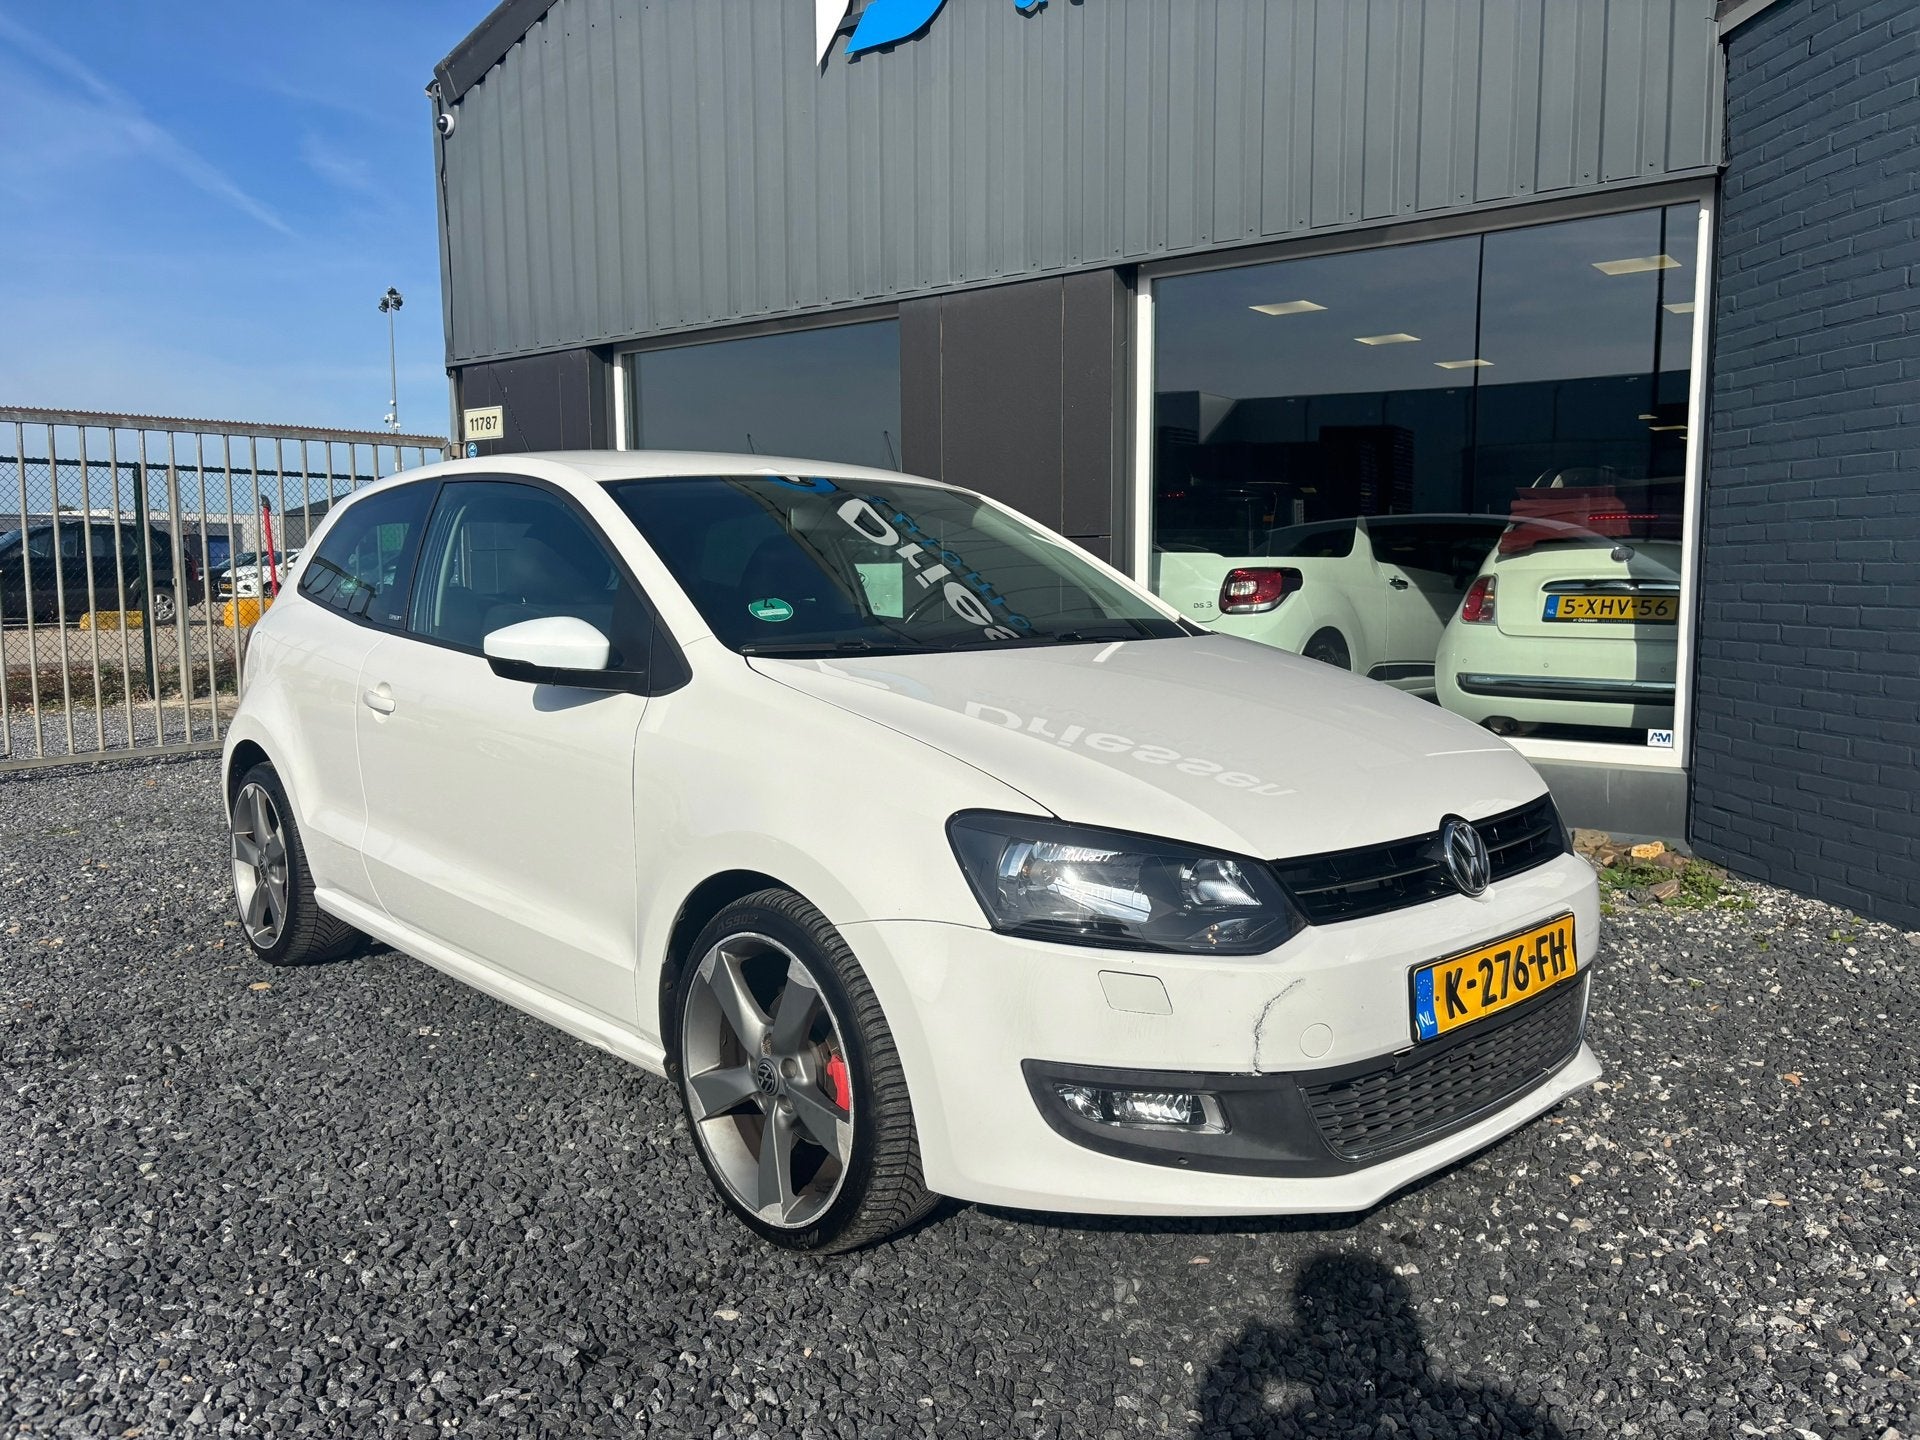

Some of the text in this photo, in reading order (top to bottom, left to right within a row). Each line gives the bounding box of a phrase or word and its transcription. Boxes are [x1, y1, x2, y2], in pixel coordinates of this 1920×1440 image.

[470, 415, 498, 431] 11787
[1563, 598, 1669, 616] 5-XHV-56
[1445, 928, 1567, 1020] K-276-FH
[1418, 1010, 1435, 1028] NL
